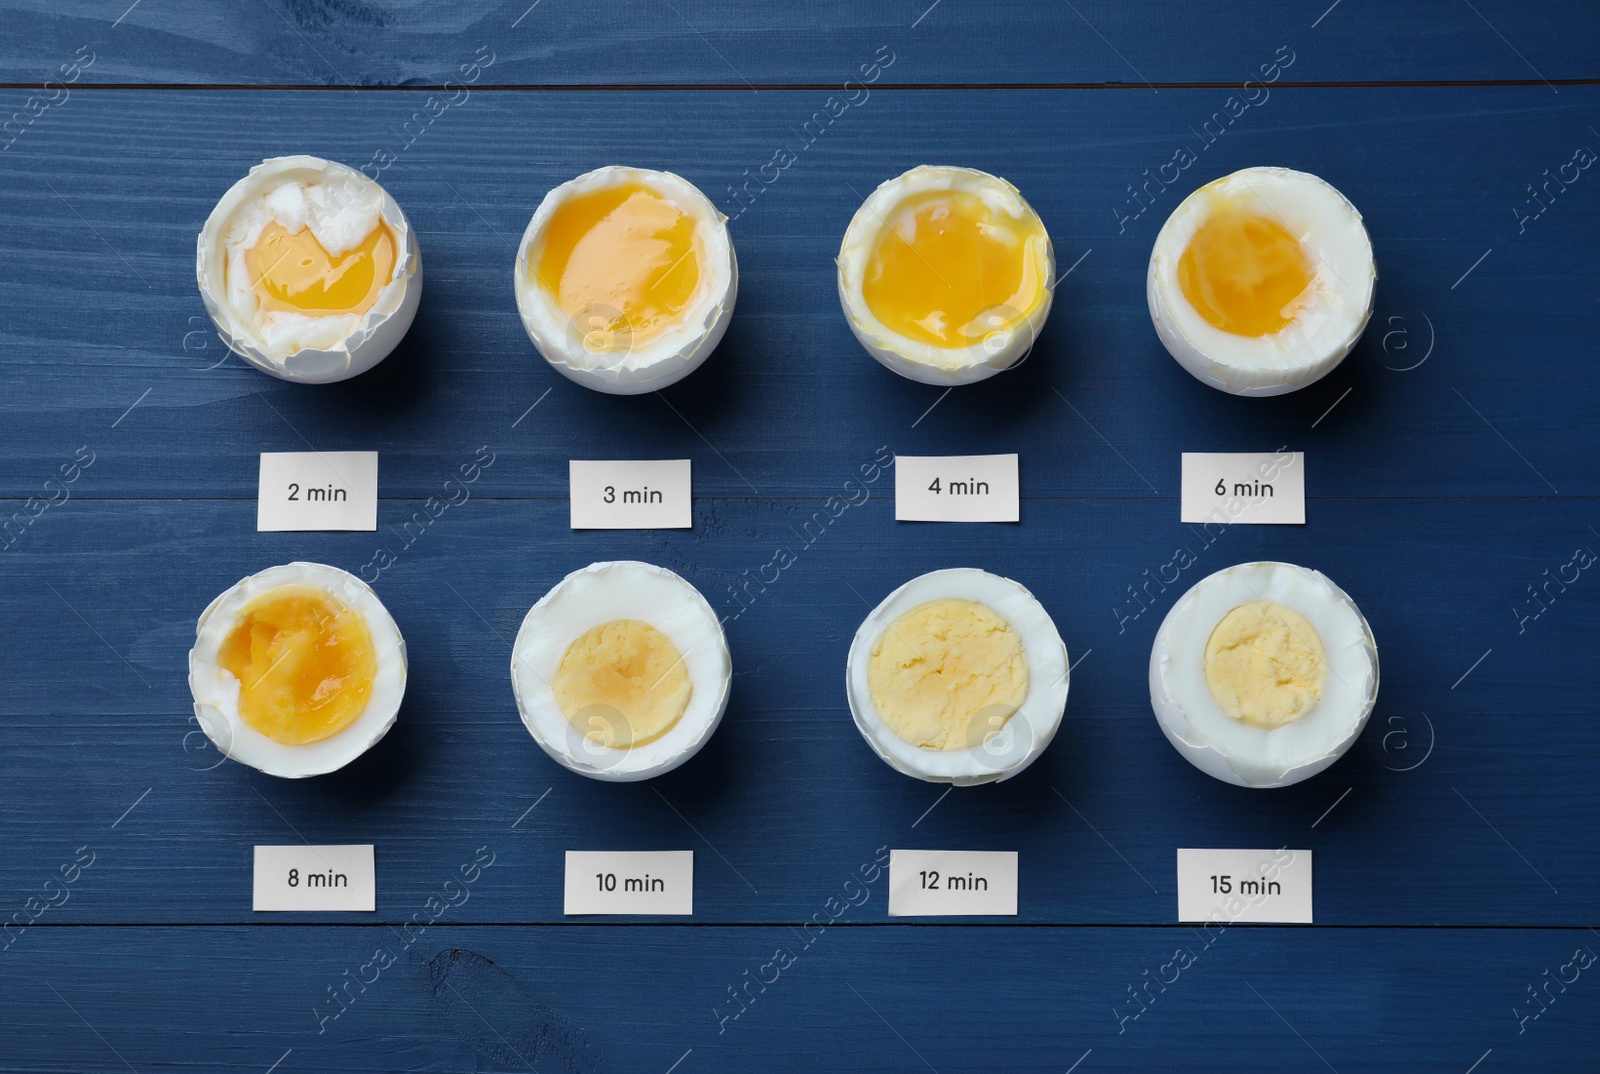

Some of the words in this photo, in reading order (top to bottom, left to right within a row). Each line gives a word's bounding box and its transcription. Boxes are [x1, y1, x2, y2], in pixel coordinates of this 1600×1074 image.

[288, 483, 300, 501] 2
[307, 484, 347, 502] min
[603, 485, 616, 504] 3
[623, 486, 663, 504] min
[928, 477, 942, 495] 4
[949, 477, 989, 495] min
[1214, 478, 1227, 496] 6
[1233, 479, 1274, 498] min
[287, 868, 300, 888] 8
[307, 868, 348, 888] min
[596, 873, 617, 892] 10
[624, 873, 665, 893] min
[919, 870, 940, 890] 12
[947, 872, 988, 891] min
[1210, 875, 1233, 895] 15
[1240, 876, 1281, 896] min
